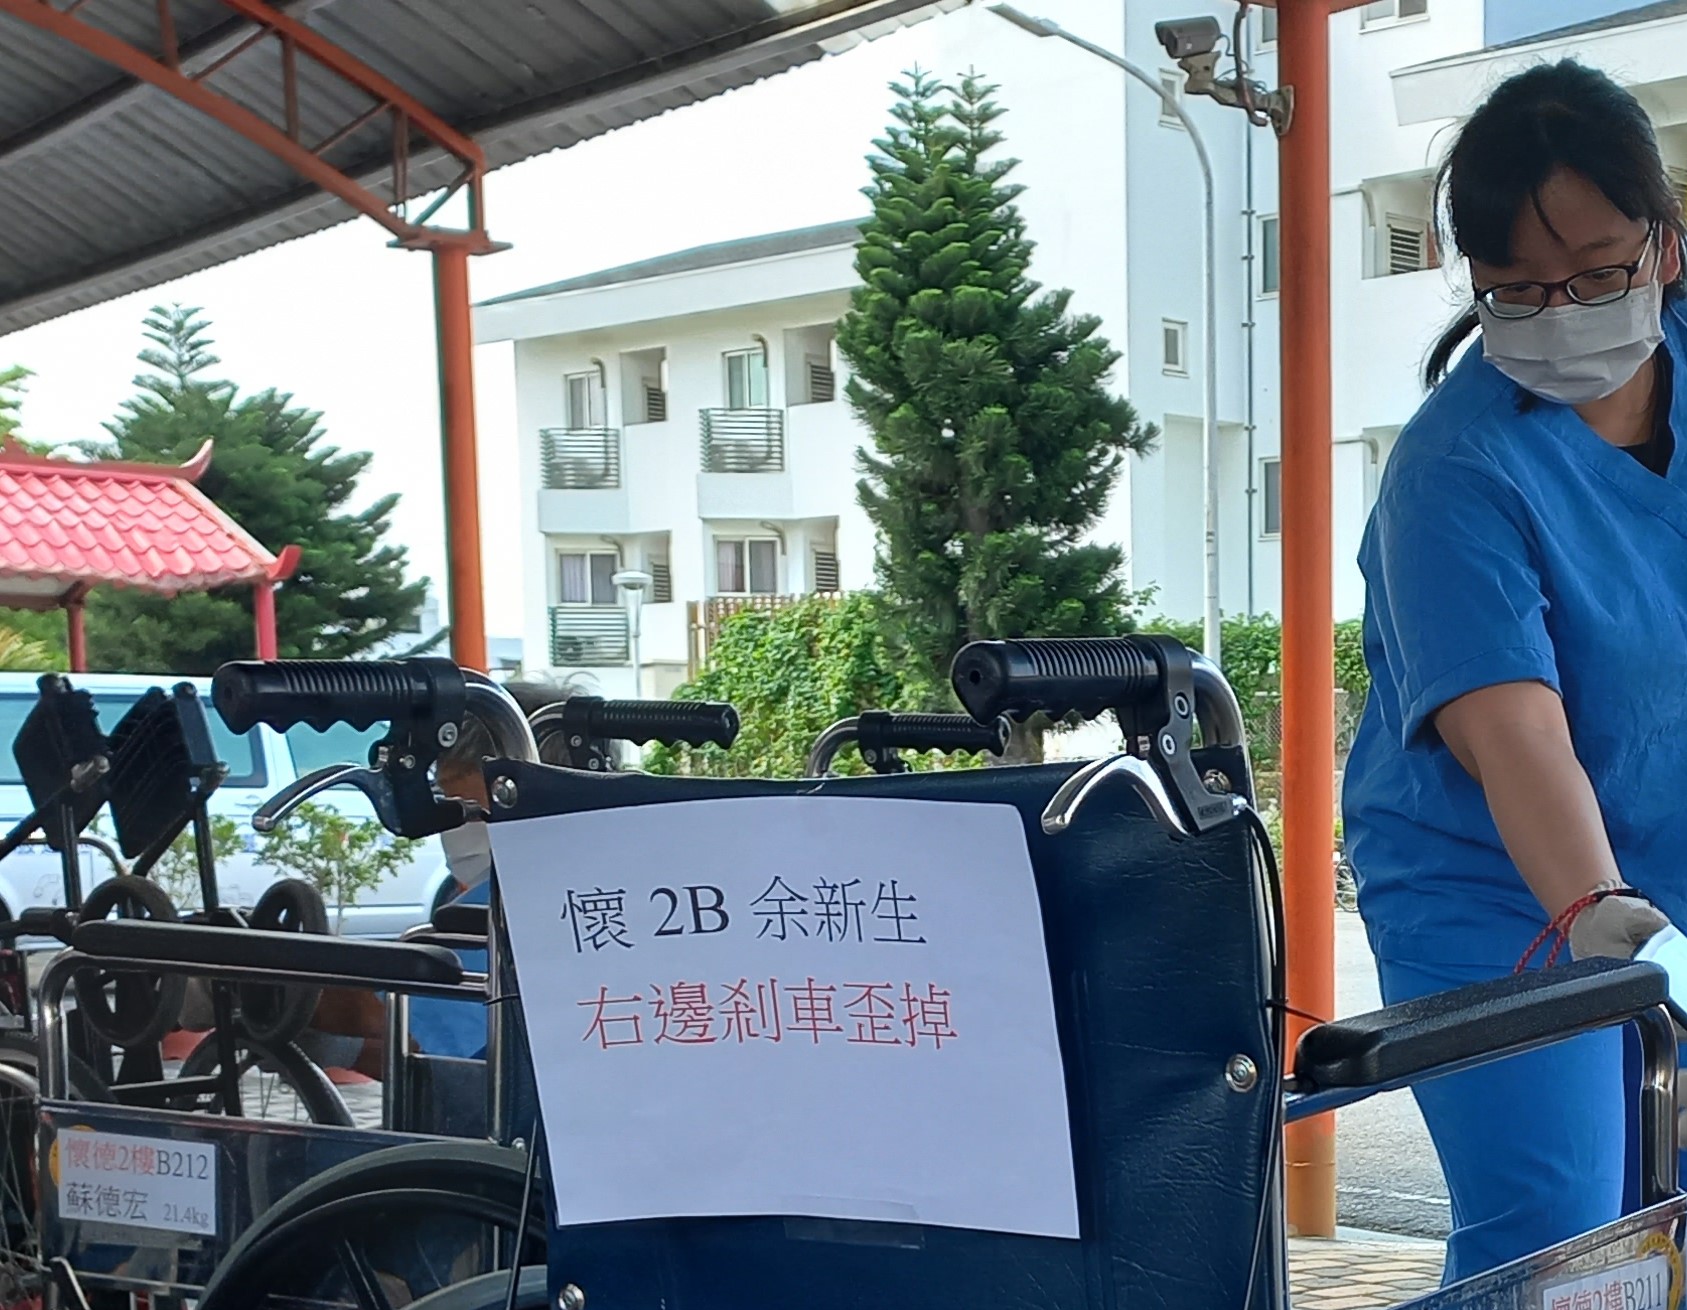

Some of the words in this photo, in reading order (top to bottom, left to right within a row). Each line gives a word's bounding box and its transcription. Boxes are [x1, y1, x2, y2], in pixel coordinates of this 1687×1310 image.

[650, 885, 730, 939] 2B
[749, 874, 928, 944] 余新生
[66, 1180, 149, 1221] 蘇德宏
[163, 1203, 209, 1228] 21.4kg
